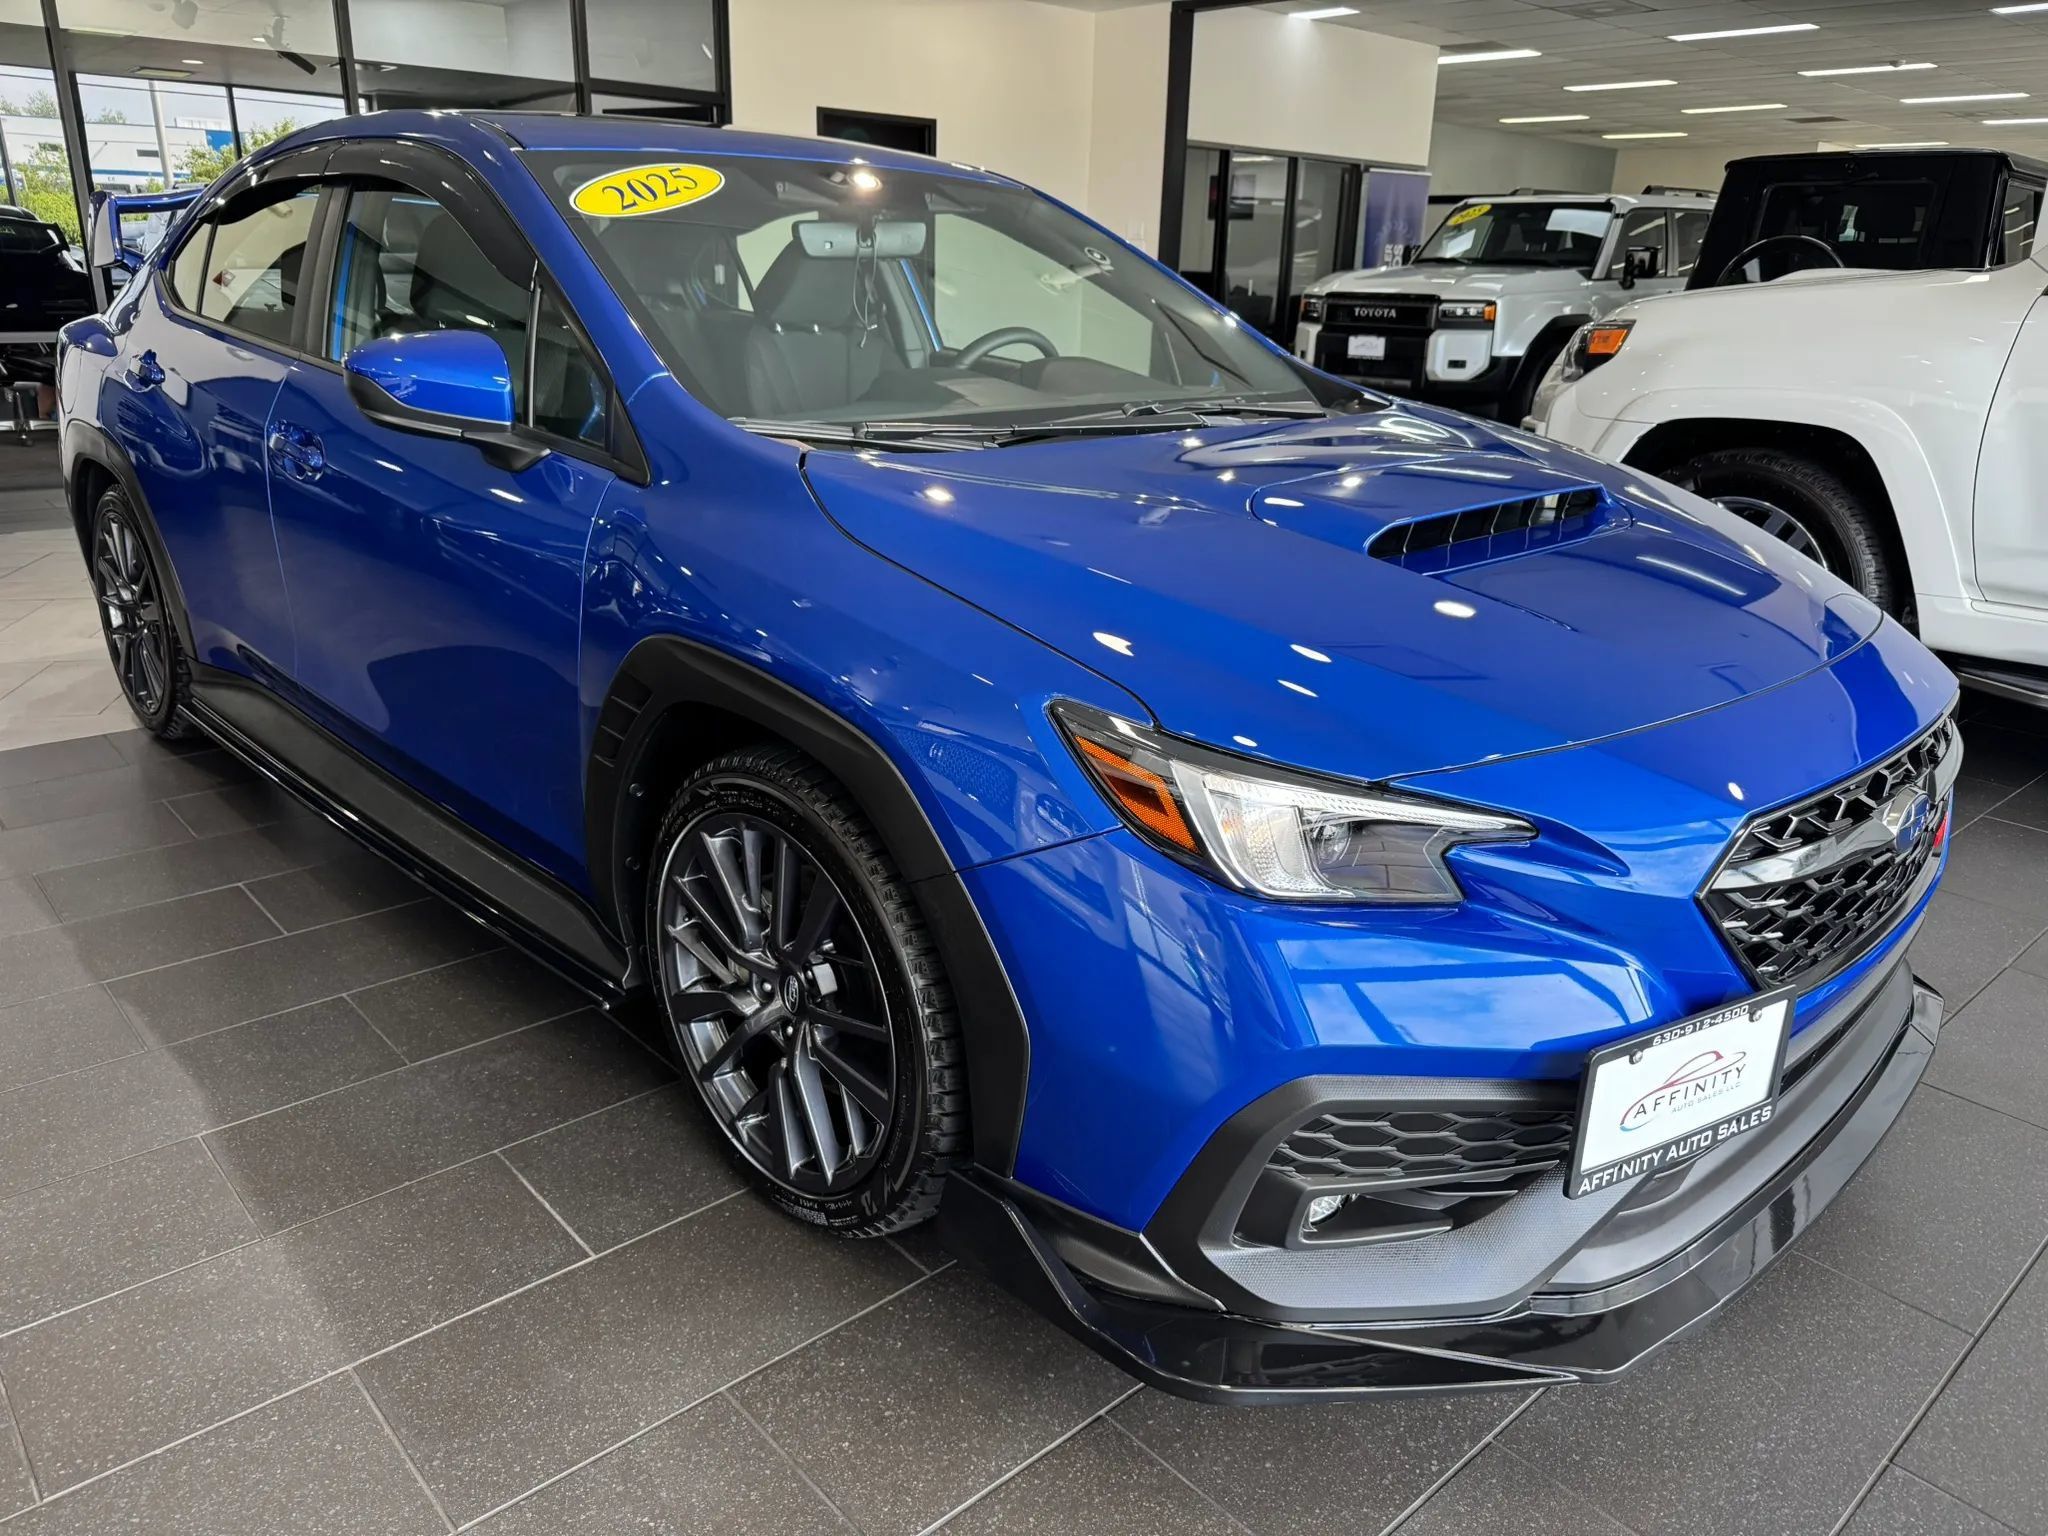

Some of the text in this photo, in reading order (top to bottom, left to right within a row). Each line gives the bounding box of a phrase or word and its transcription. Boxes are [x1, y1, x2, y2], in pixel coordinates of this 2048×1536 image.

[602, 167, 698, 211] 2025
[1353, 306, 1397, 319] TOYOTA
[1652, 1004, 1750, 1047] 630-912-4500
[1633, 1063, 1747, 1119] AFFINITY
[1578, 1105, 1772, 1196] AFFINITY AUTO SALES
